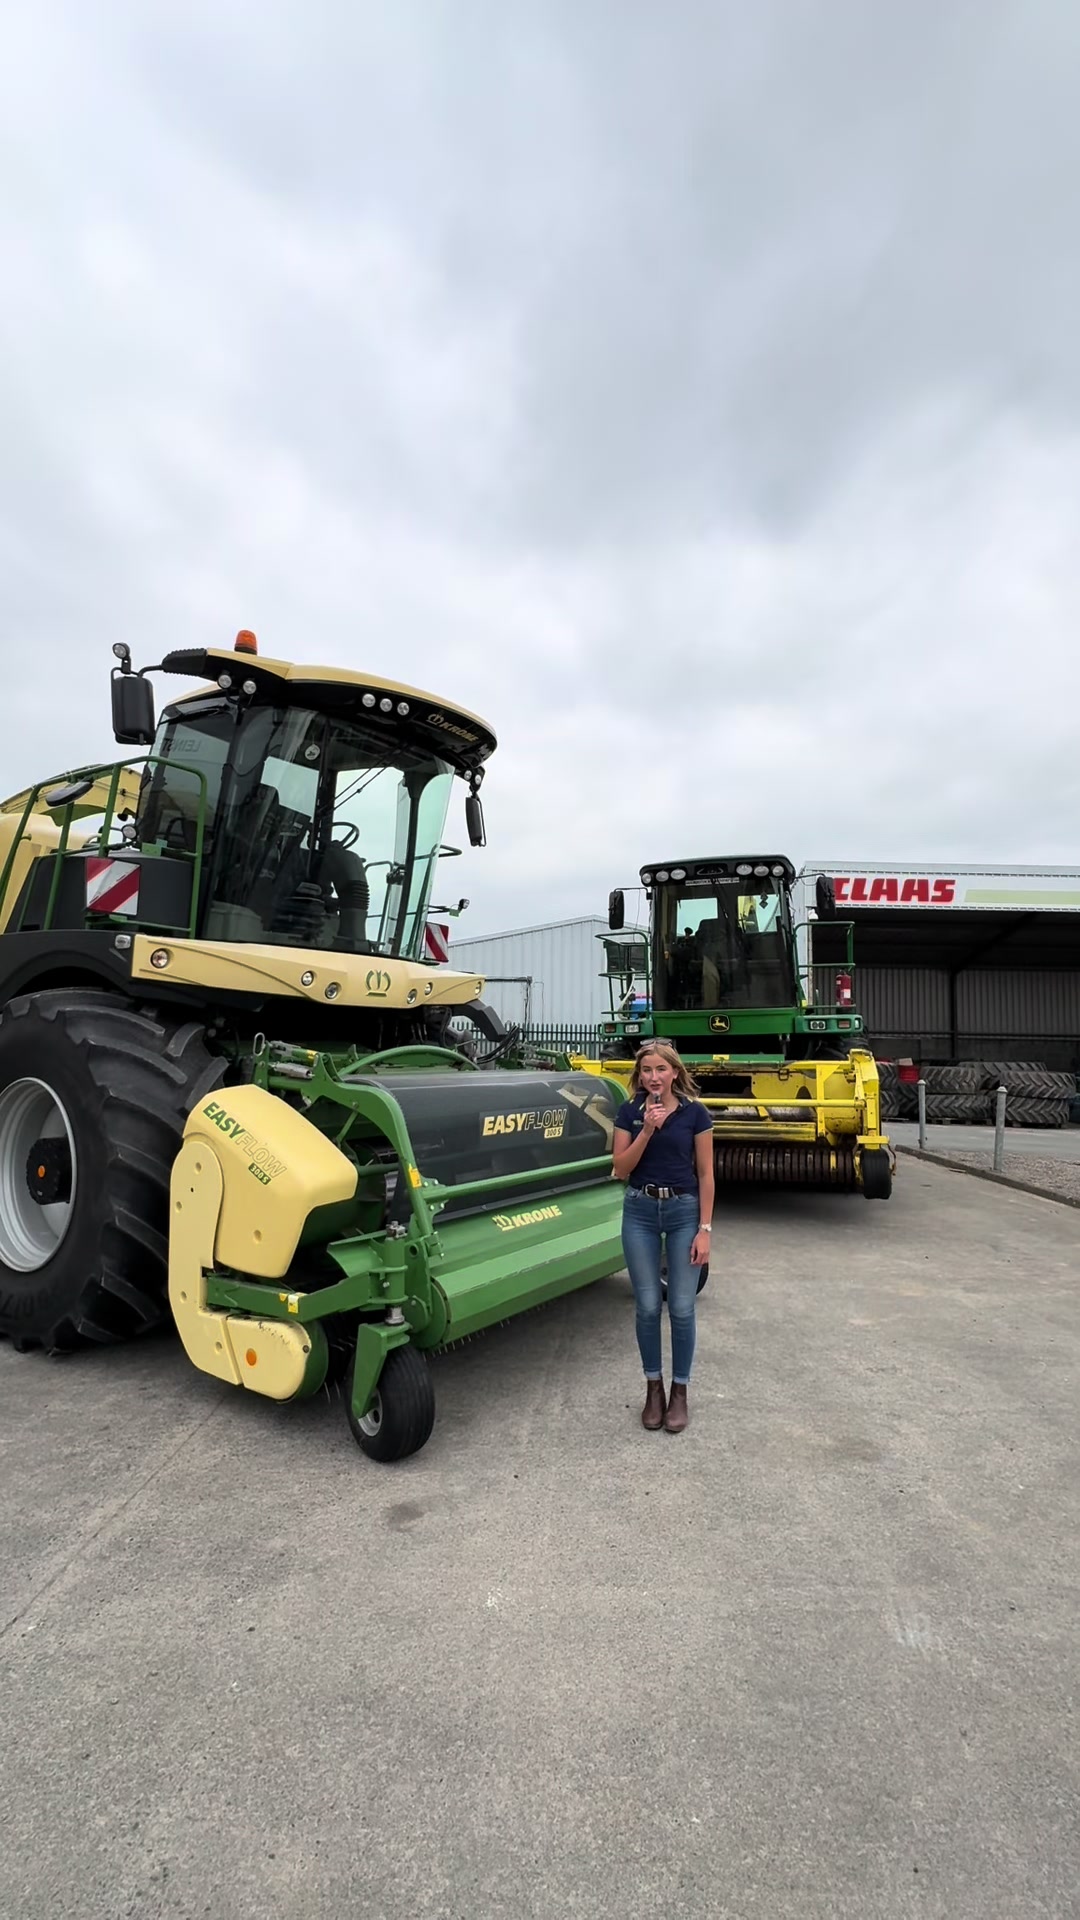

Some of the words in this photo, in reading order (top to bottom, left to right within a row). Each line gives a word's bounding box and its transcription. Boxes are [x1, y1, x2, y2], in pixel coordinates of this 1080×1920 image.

[439, 721, 479, 742] KRONE
[833, 877, 956, 903] CLAAS
[482, 1108, 567, 1137] EASYFLOW
[202, 1101, 288, 1179] EASYFLOW
[511, 1204, 563, 1228] KRONE
